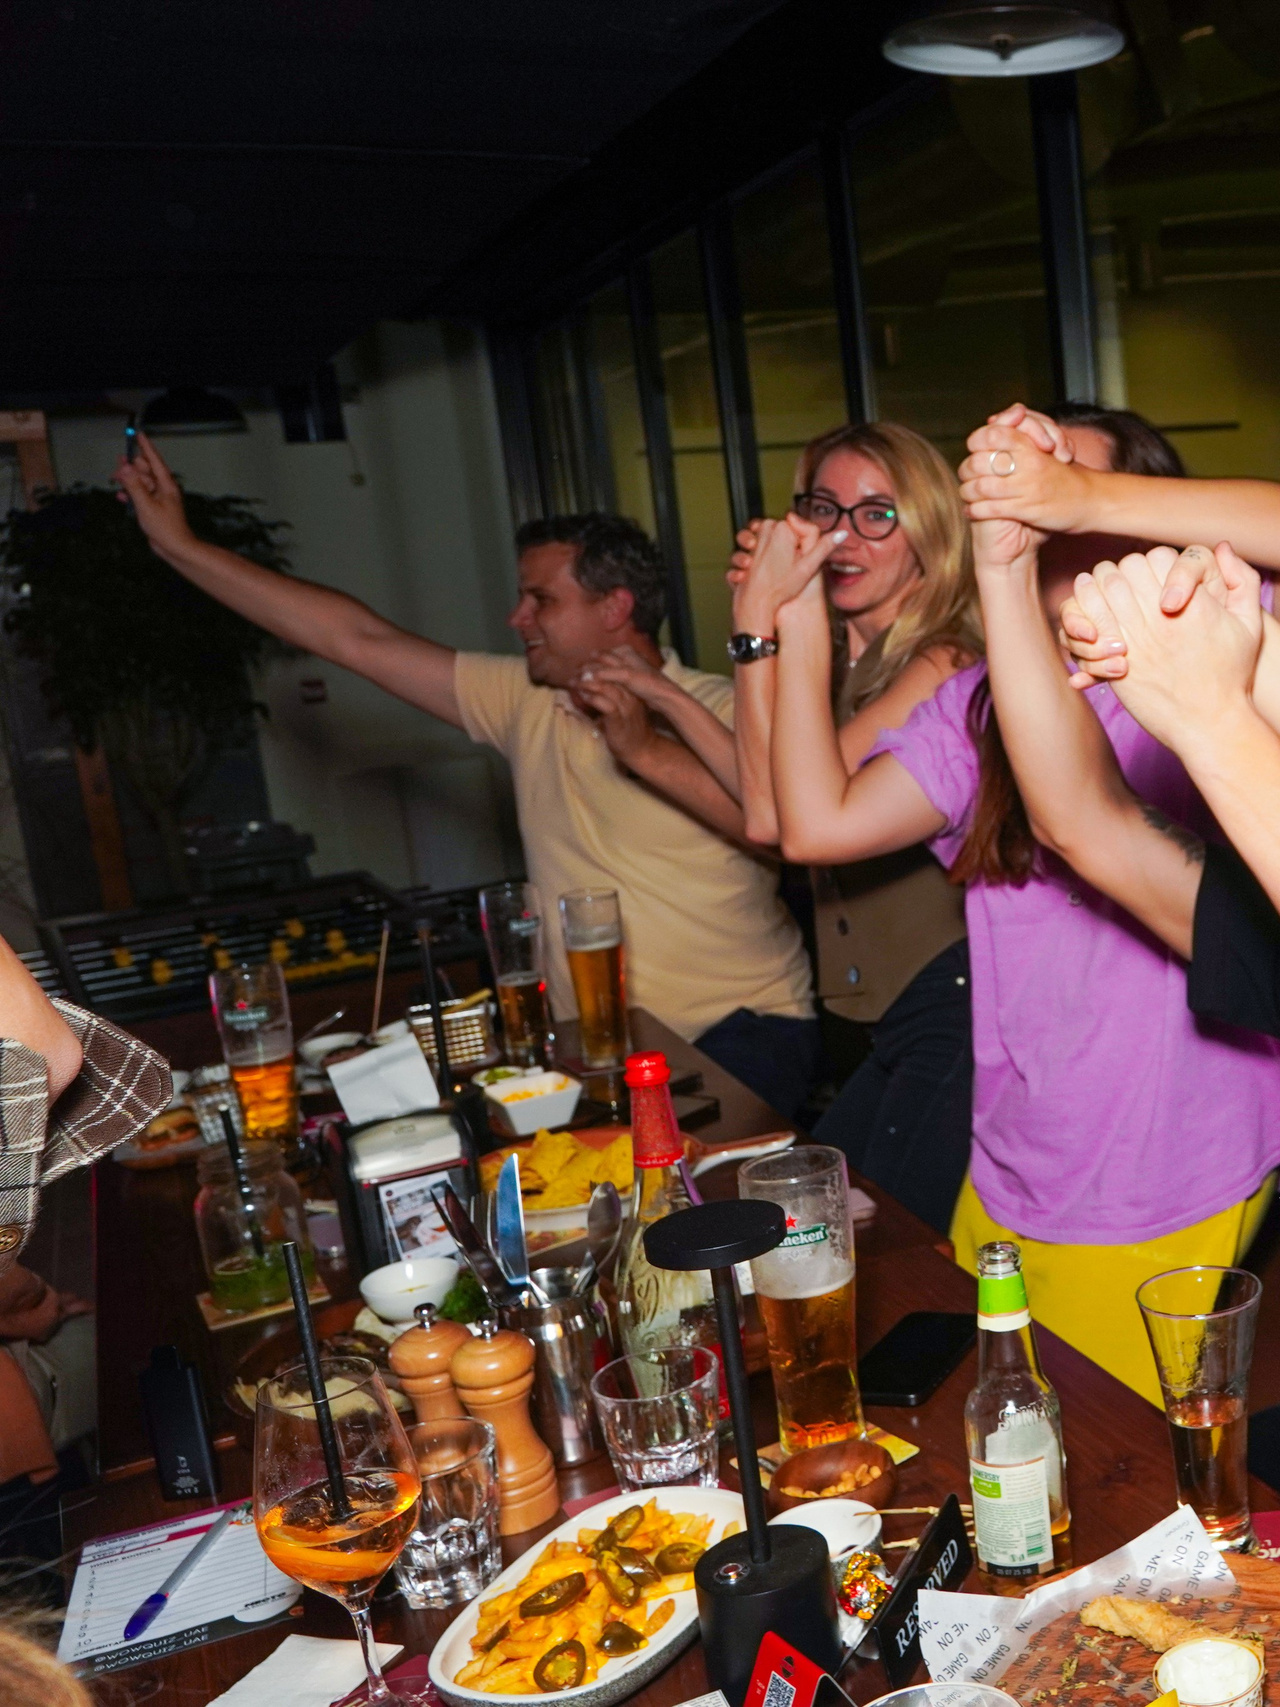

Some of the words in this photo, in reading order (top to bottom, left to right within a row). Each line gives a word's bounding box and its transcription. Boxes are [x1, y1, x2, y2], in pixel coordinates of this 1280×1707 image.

[778, 1227, 825, 1247] neken
[1145, 1553, 1160, 1574] ME
[1170, 1545, 1188, 1565] ON
[1184, 1550, 1211, 1589] GAME
[1111, 1572, 1130, 1597] GAM
[1135, 1577, 1151, 1597] ON
[895, 1539, 959, 1657] RESRVED
[1156, 1587, 1171, 1604] GA
[949, 1618, 968, 1637] ME
[974, 1627, 992, 1646] ON
[94, 1625, 209, 1663] @WOWQUIZ_UAE
[936, 1632, 954, 1651] ON
[1024, 1624, 1050, 1655] GAME
[93, 1633, 209, 1673] @WOWQUIZ_UAE
[983, 1642, 1010, 1670] GAME
[1012, 1651, 1029, 1669] ON
[942, 1650, 969, 1679] GAME
[970, 1666, 988, 1684] ON
[1024, 1653, 1051, 1686] GAME
